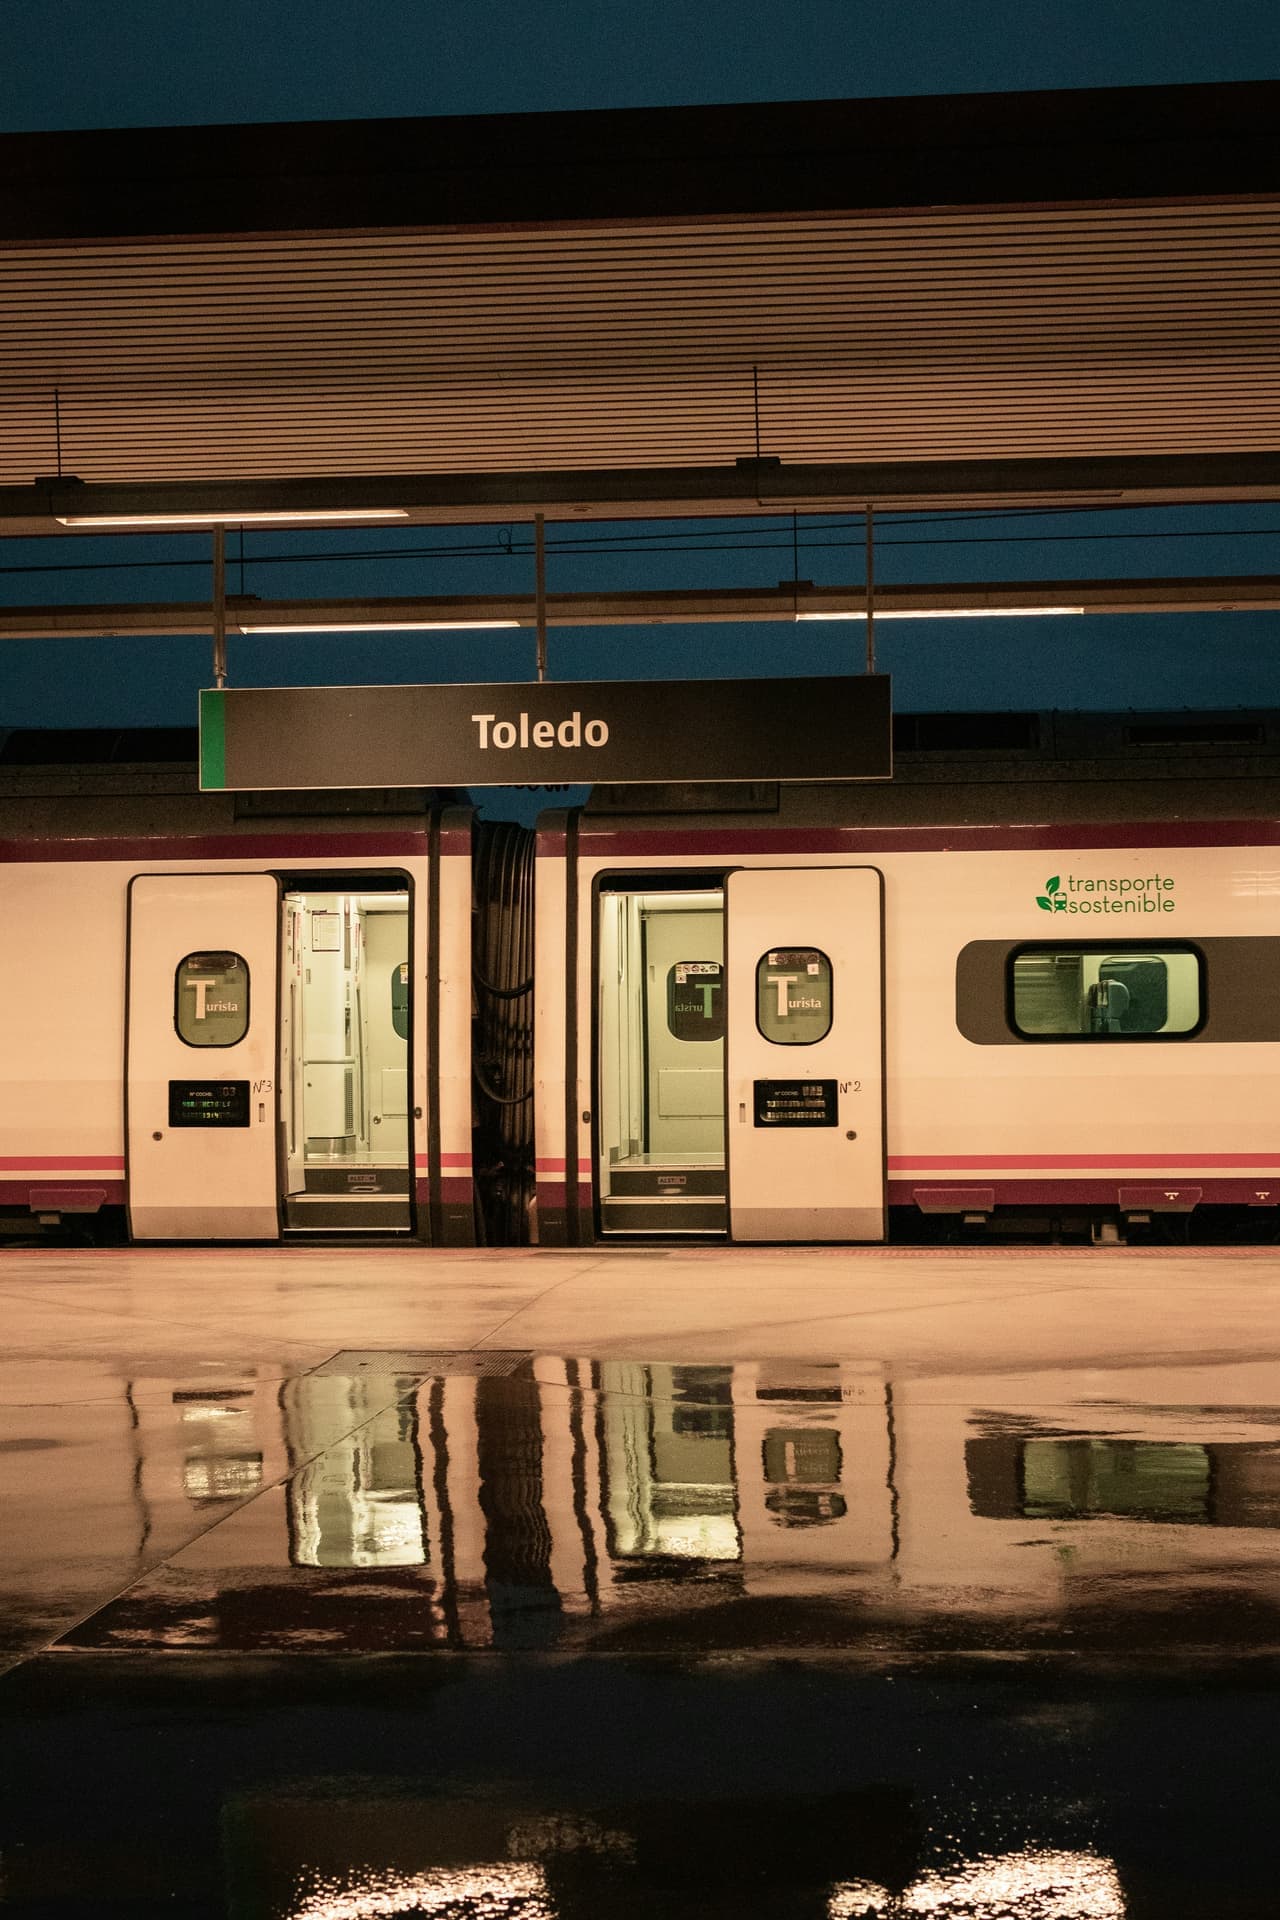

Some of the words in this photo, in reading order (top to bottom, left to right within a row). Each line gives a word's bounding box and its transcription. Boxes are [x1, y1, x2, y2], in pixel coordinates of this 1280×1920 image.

[471, 711, 610, 750] Toledo
[1068, 874, 1175, 897] transporte
[1068, 893, 1176, 914] sostenible
[186, 979, 238, 1019] Turista
[767, 975, 822, 1016] Turista
